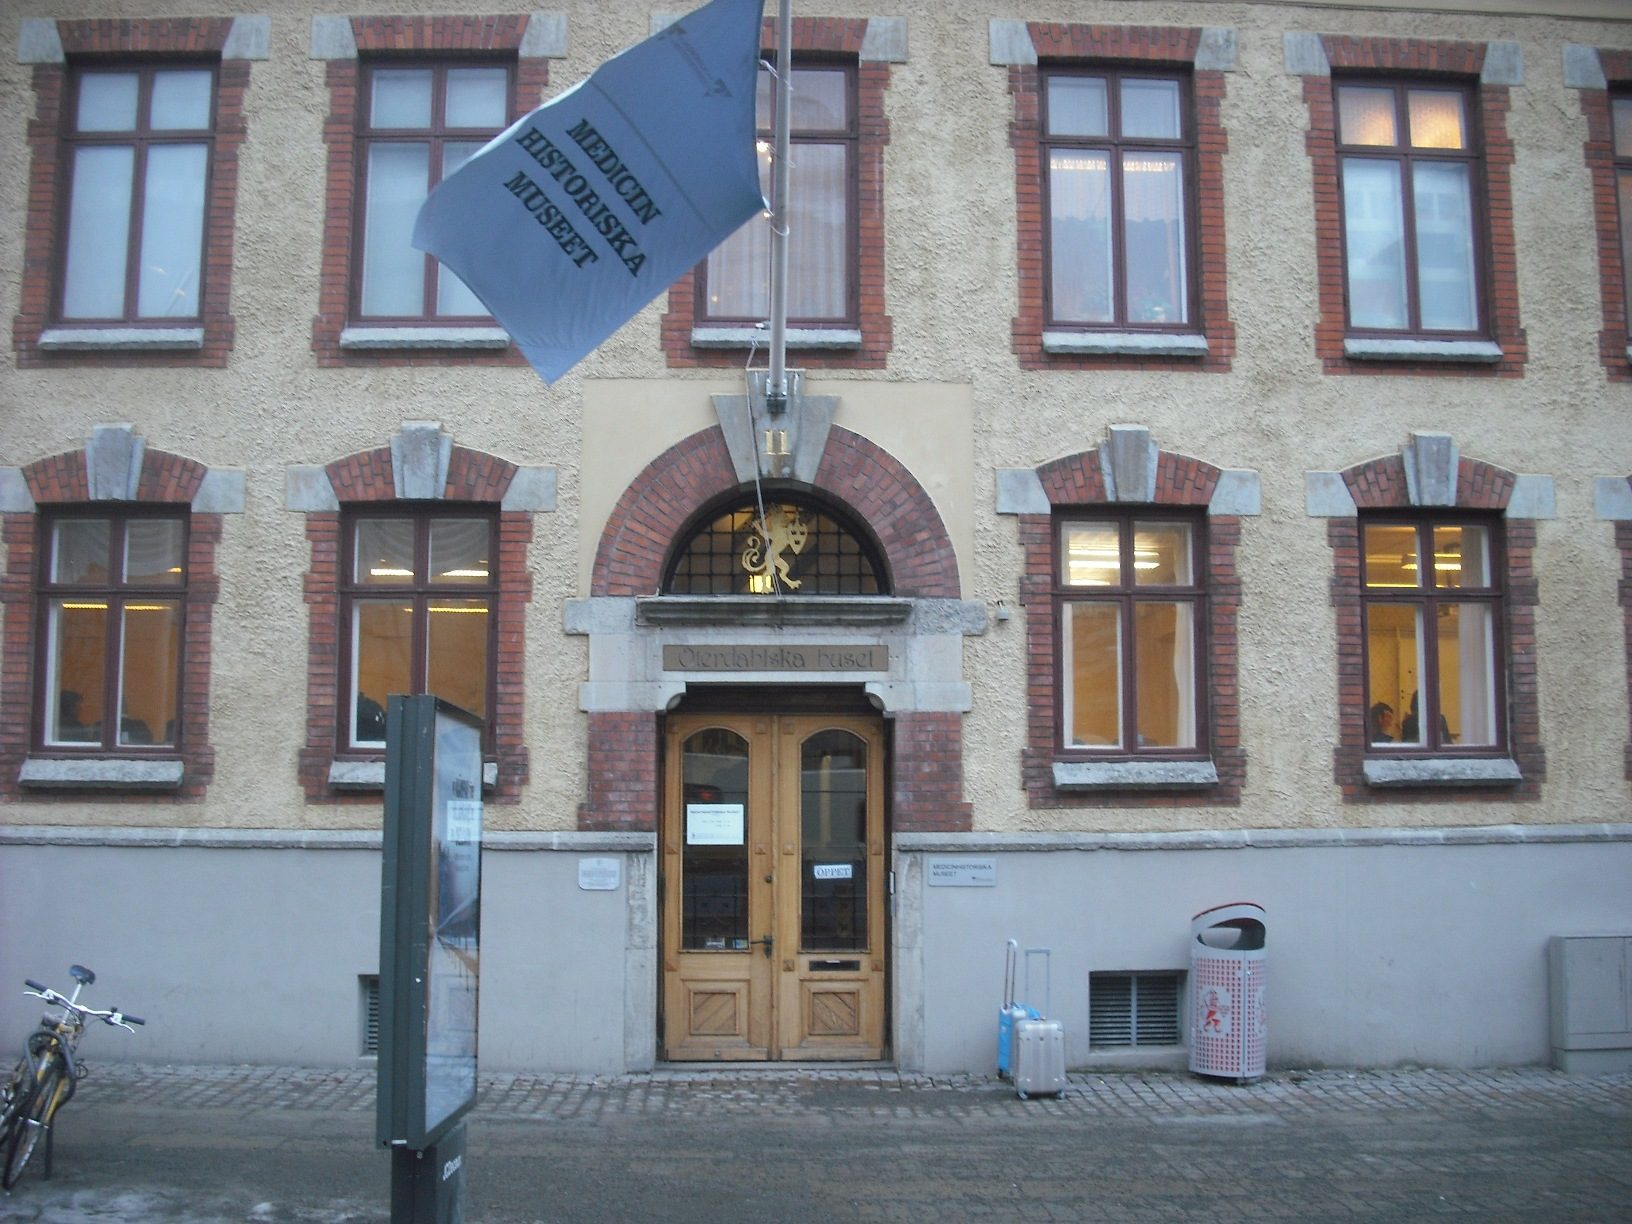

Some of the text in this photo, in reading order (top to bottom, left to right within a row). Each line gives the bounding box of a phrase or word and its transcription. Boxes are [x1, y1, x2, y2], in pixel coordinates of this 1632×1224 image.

[503, 170, 600, 269] MUSEET
[515, 126, 647, 278] HISTORISKA
[566, 118, 663, 226] MEDICIN
[761, 429, 791, 456] 11
